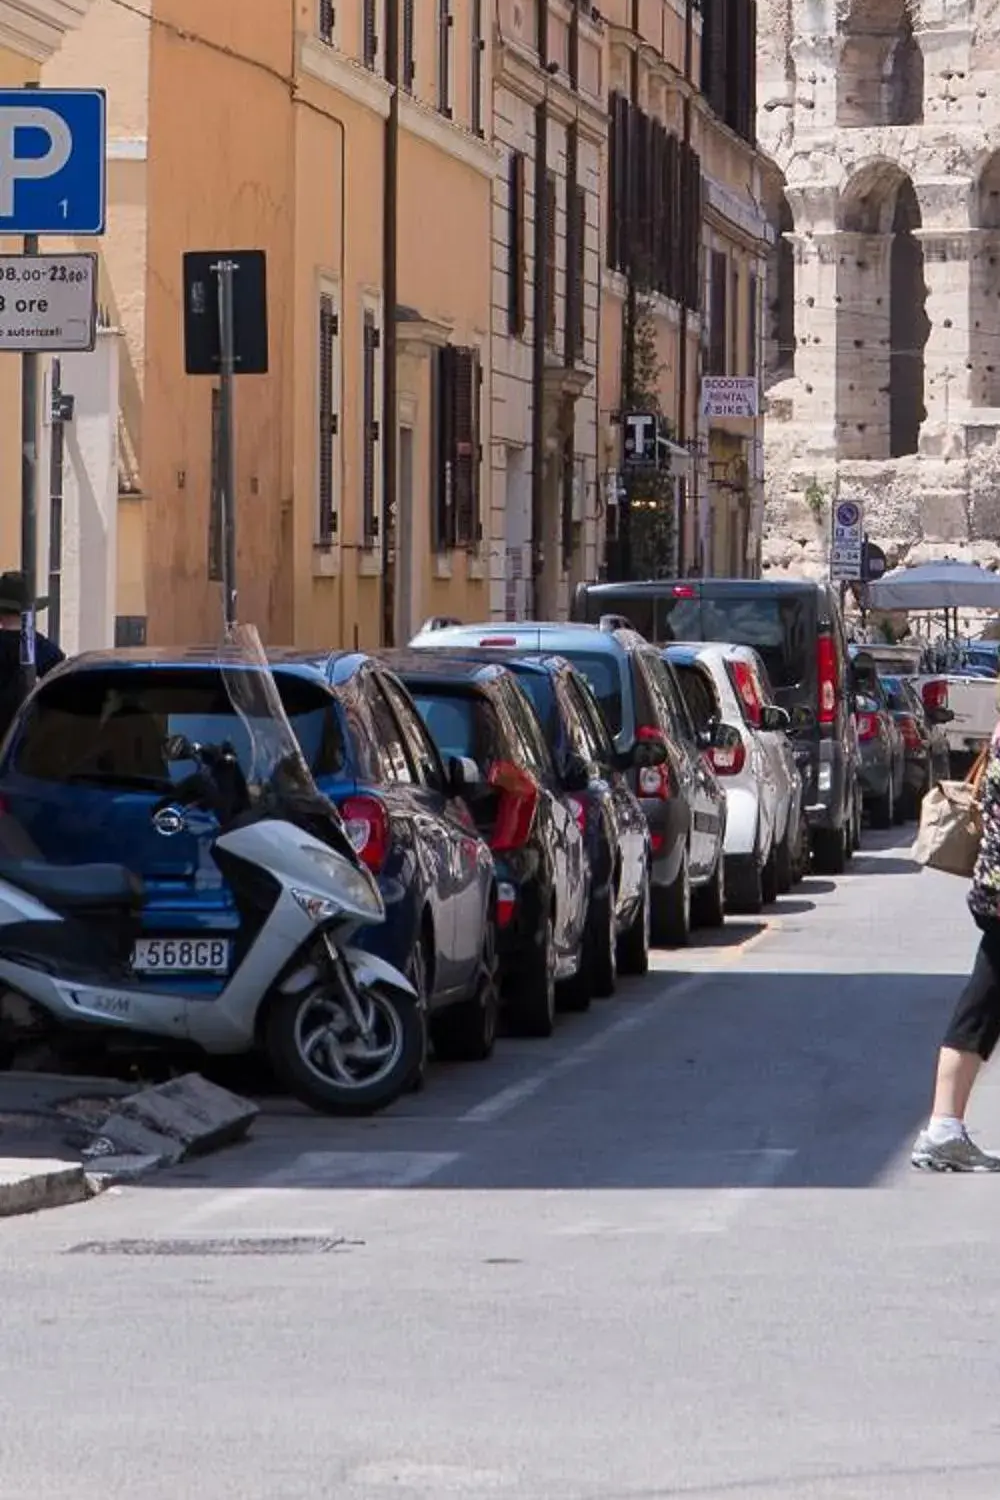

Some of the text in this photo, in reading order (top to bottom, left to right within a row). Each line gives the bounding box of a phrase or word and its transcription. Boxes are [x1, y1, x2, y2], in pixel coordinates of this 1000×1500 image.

[0, 105, 73, 217] P
[58, 198, 68, 219] 1
[15, 299, 49, 313] ore
[704, 379, 754, 389] SCOOTER
[715, 404, 743, 415] BIKE
[627, 415, 653, 453] T
